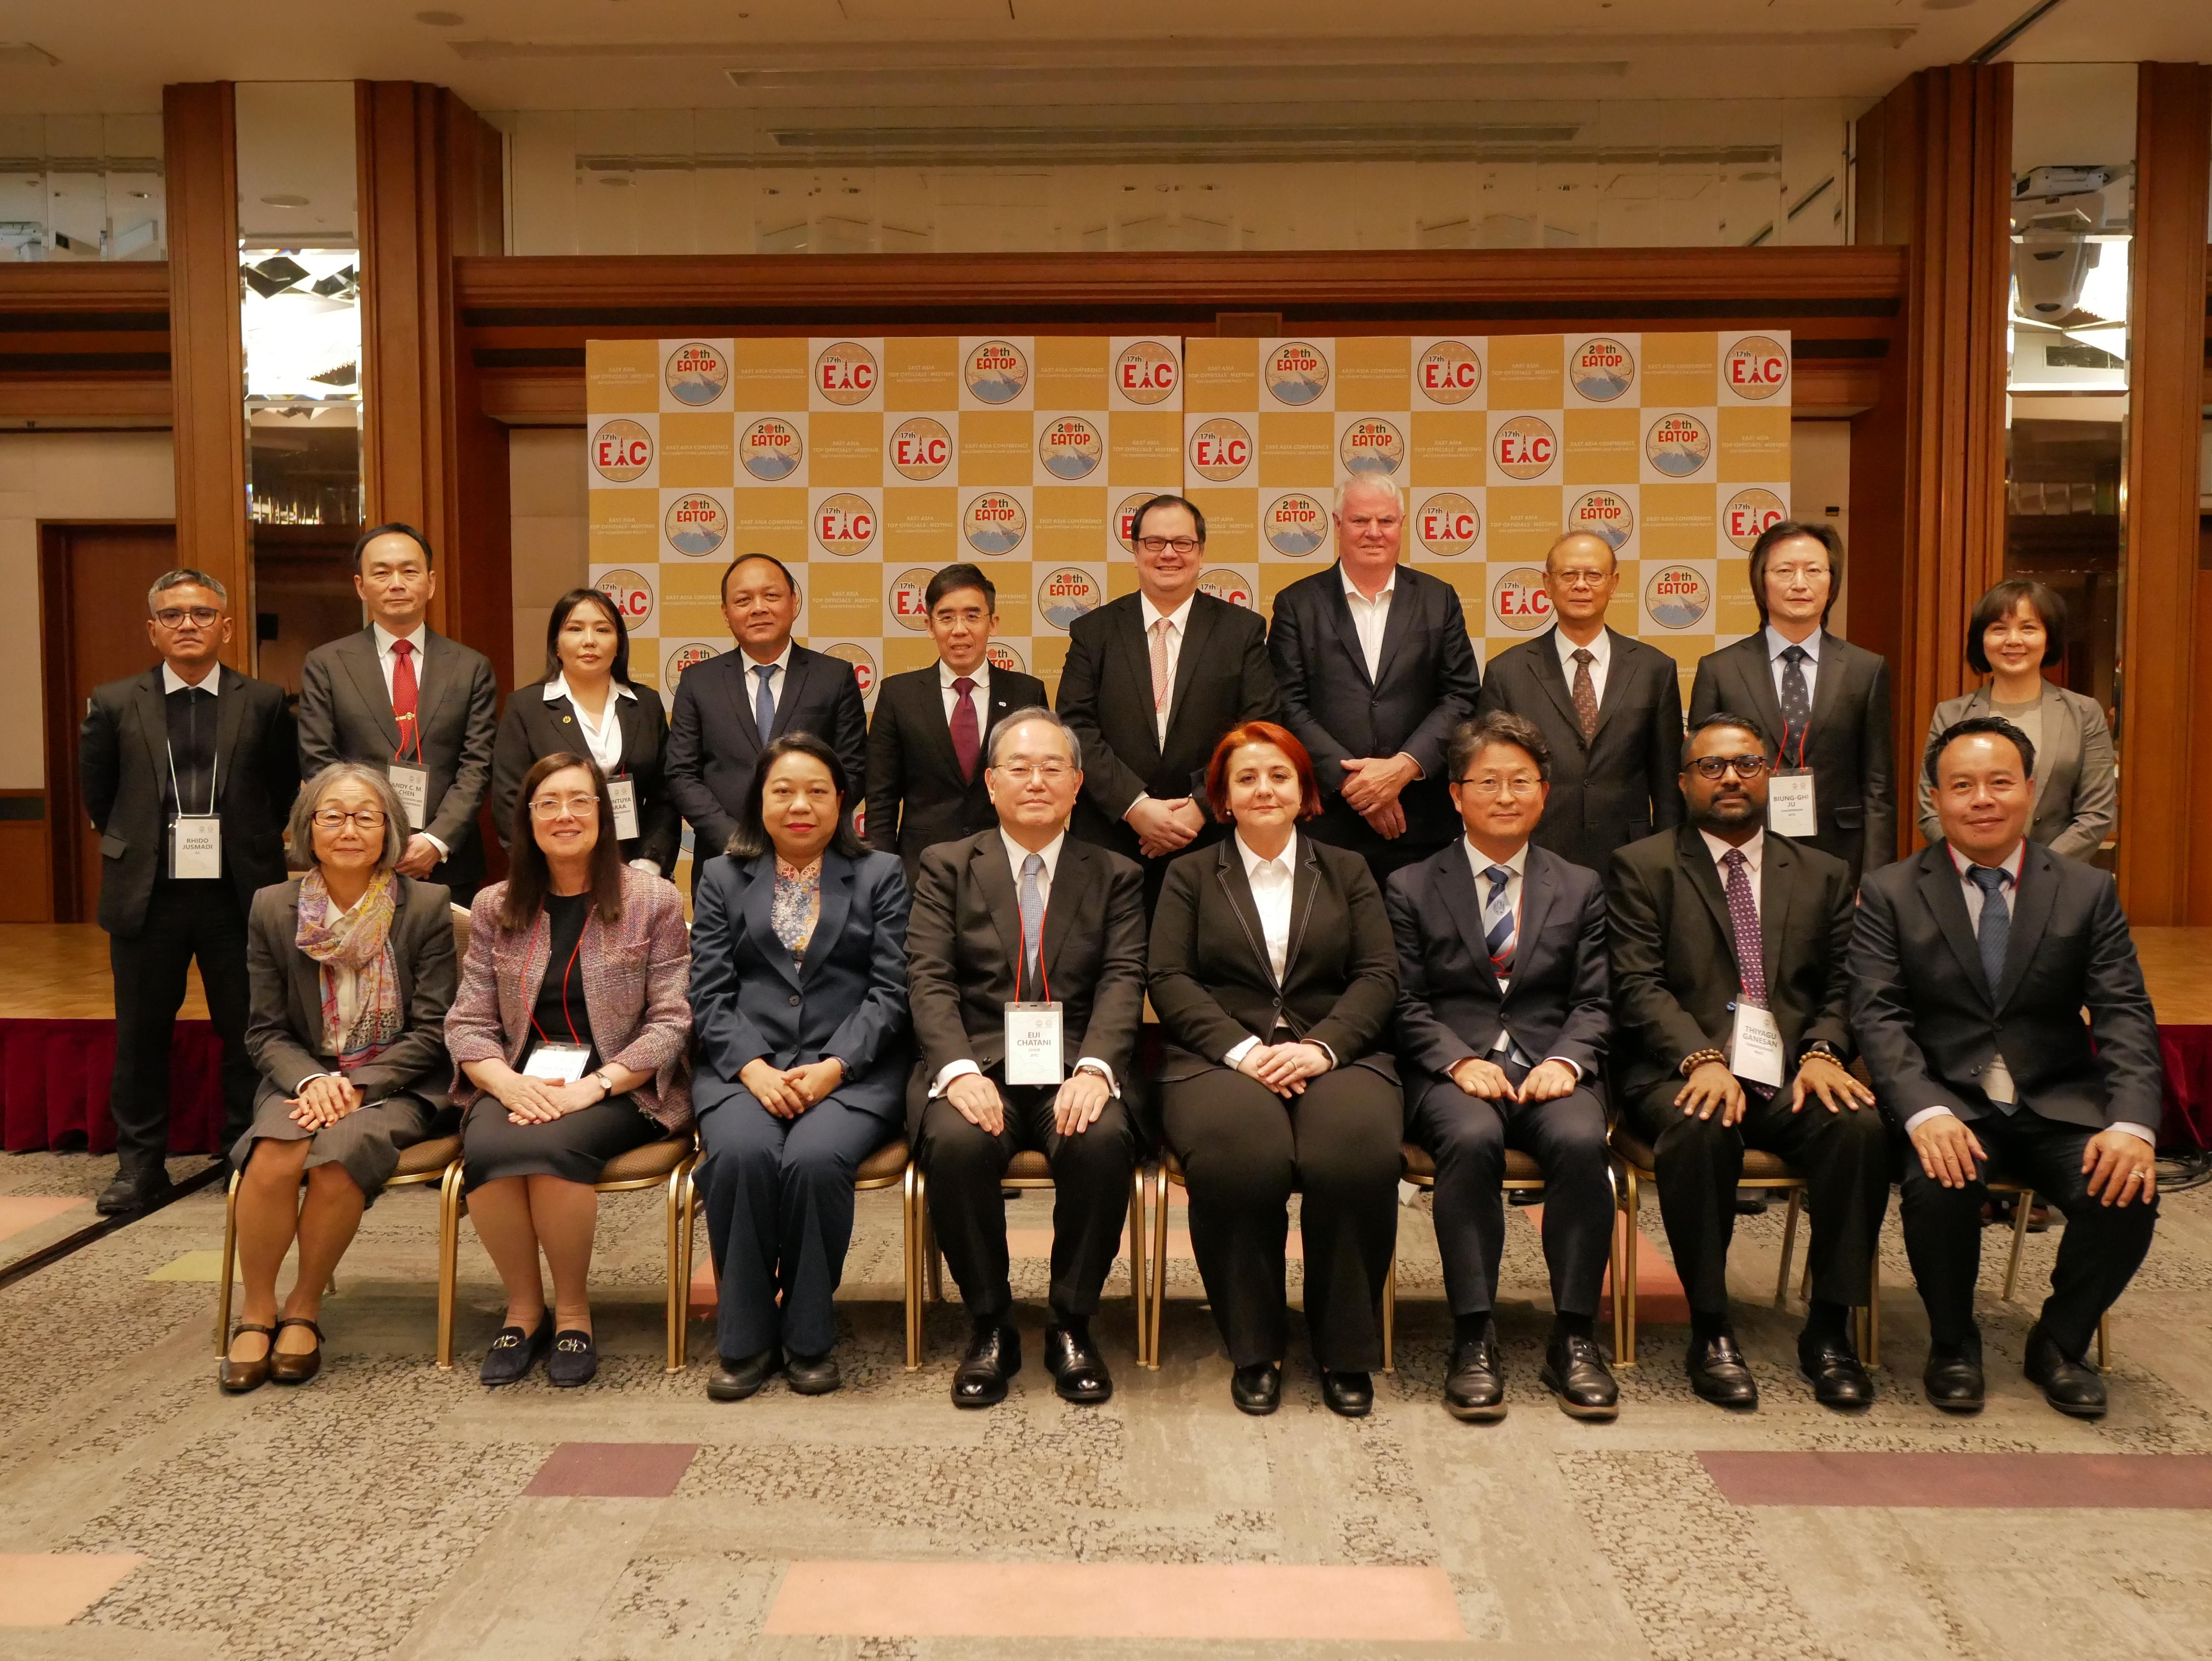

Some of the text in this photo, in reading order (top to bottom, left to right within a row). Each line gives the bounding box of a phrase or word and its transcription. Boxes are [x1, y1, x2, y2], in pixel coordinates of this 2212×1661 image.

[677, 360, 716, 371] EATOP
[976, 357, 1016, 369] EATOP
[1277, 359, 1317, 370] EATOP
[1582, 355, 1622, 367] EATOP
[751, 435, 790, 446] EATOP
[1051, 433, 1091, 445] EATOP
[1352, 435, 1392, 446] EATOP
[1658, 430, 1698, 442] EATOP
[677, 510, 716, 522] EATOP
[975, 509, 1014, 520] EATOP
[1276, 510, 1316, 522] EATOP
[1580, 507, 1621, 519] EATOP
[1050, 584, 1089, 595] EATOP
[1657, 582, 1698, 594] EATOP
[991, 659, 1014, 671] TOP
[1745, 1026, 1777, 1040] THIYAGU
[1743, 1033, 1778, 1047] GANESAN
